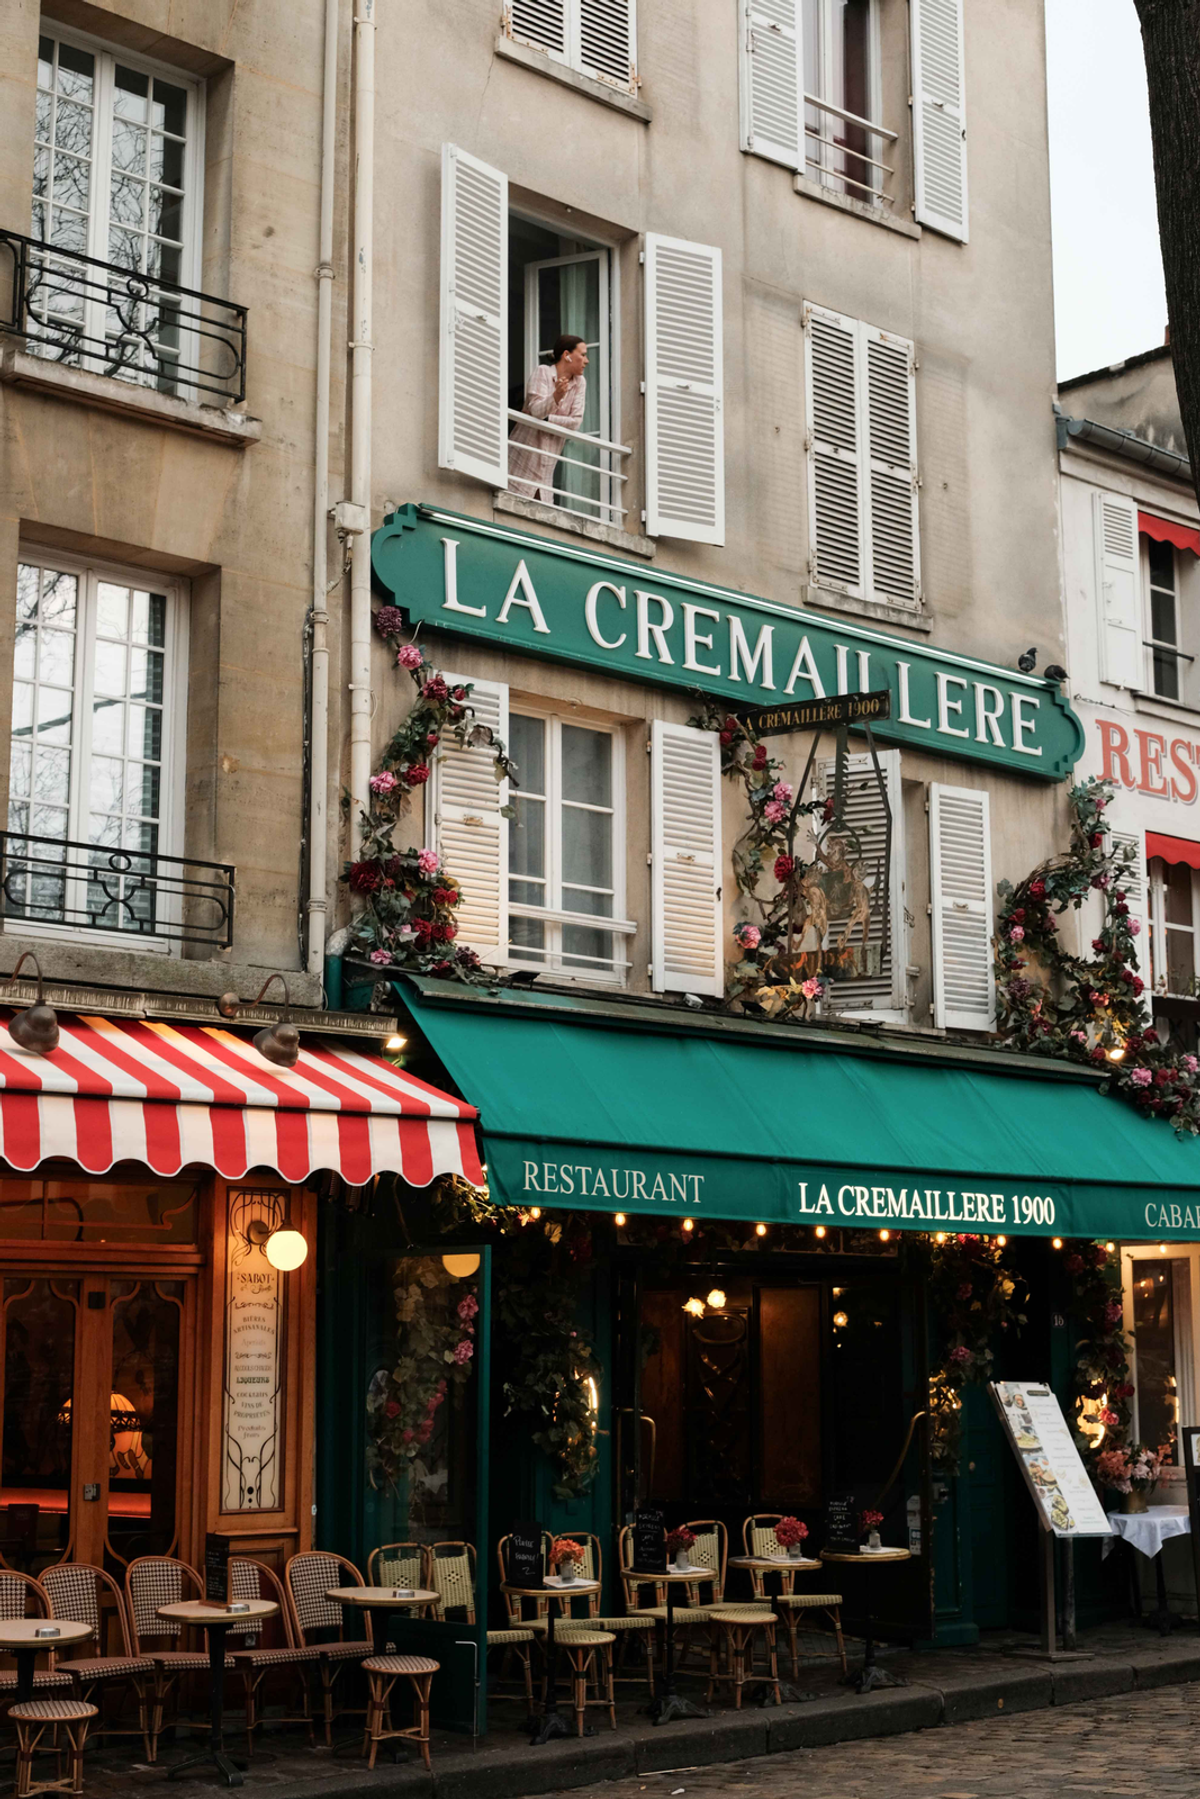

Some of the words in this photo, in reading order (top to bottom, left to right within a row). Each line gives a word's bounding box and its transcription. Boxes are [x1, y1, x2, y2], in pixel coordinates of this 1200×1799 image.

[440, 537, 551, 635] LA
[1095, 718, 1200, 806] RES
[523, 1160, 705, 1206] RESTAURANT
[798, 1182, 834, 1215] LA
[837, 1184, 1007, 1224] CREMAILLERE
[1010, 1194, 1056, 1226] 1900
[240, 1272, 272, 1284] SABOT
